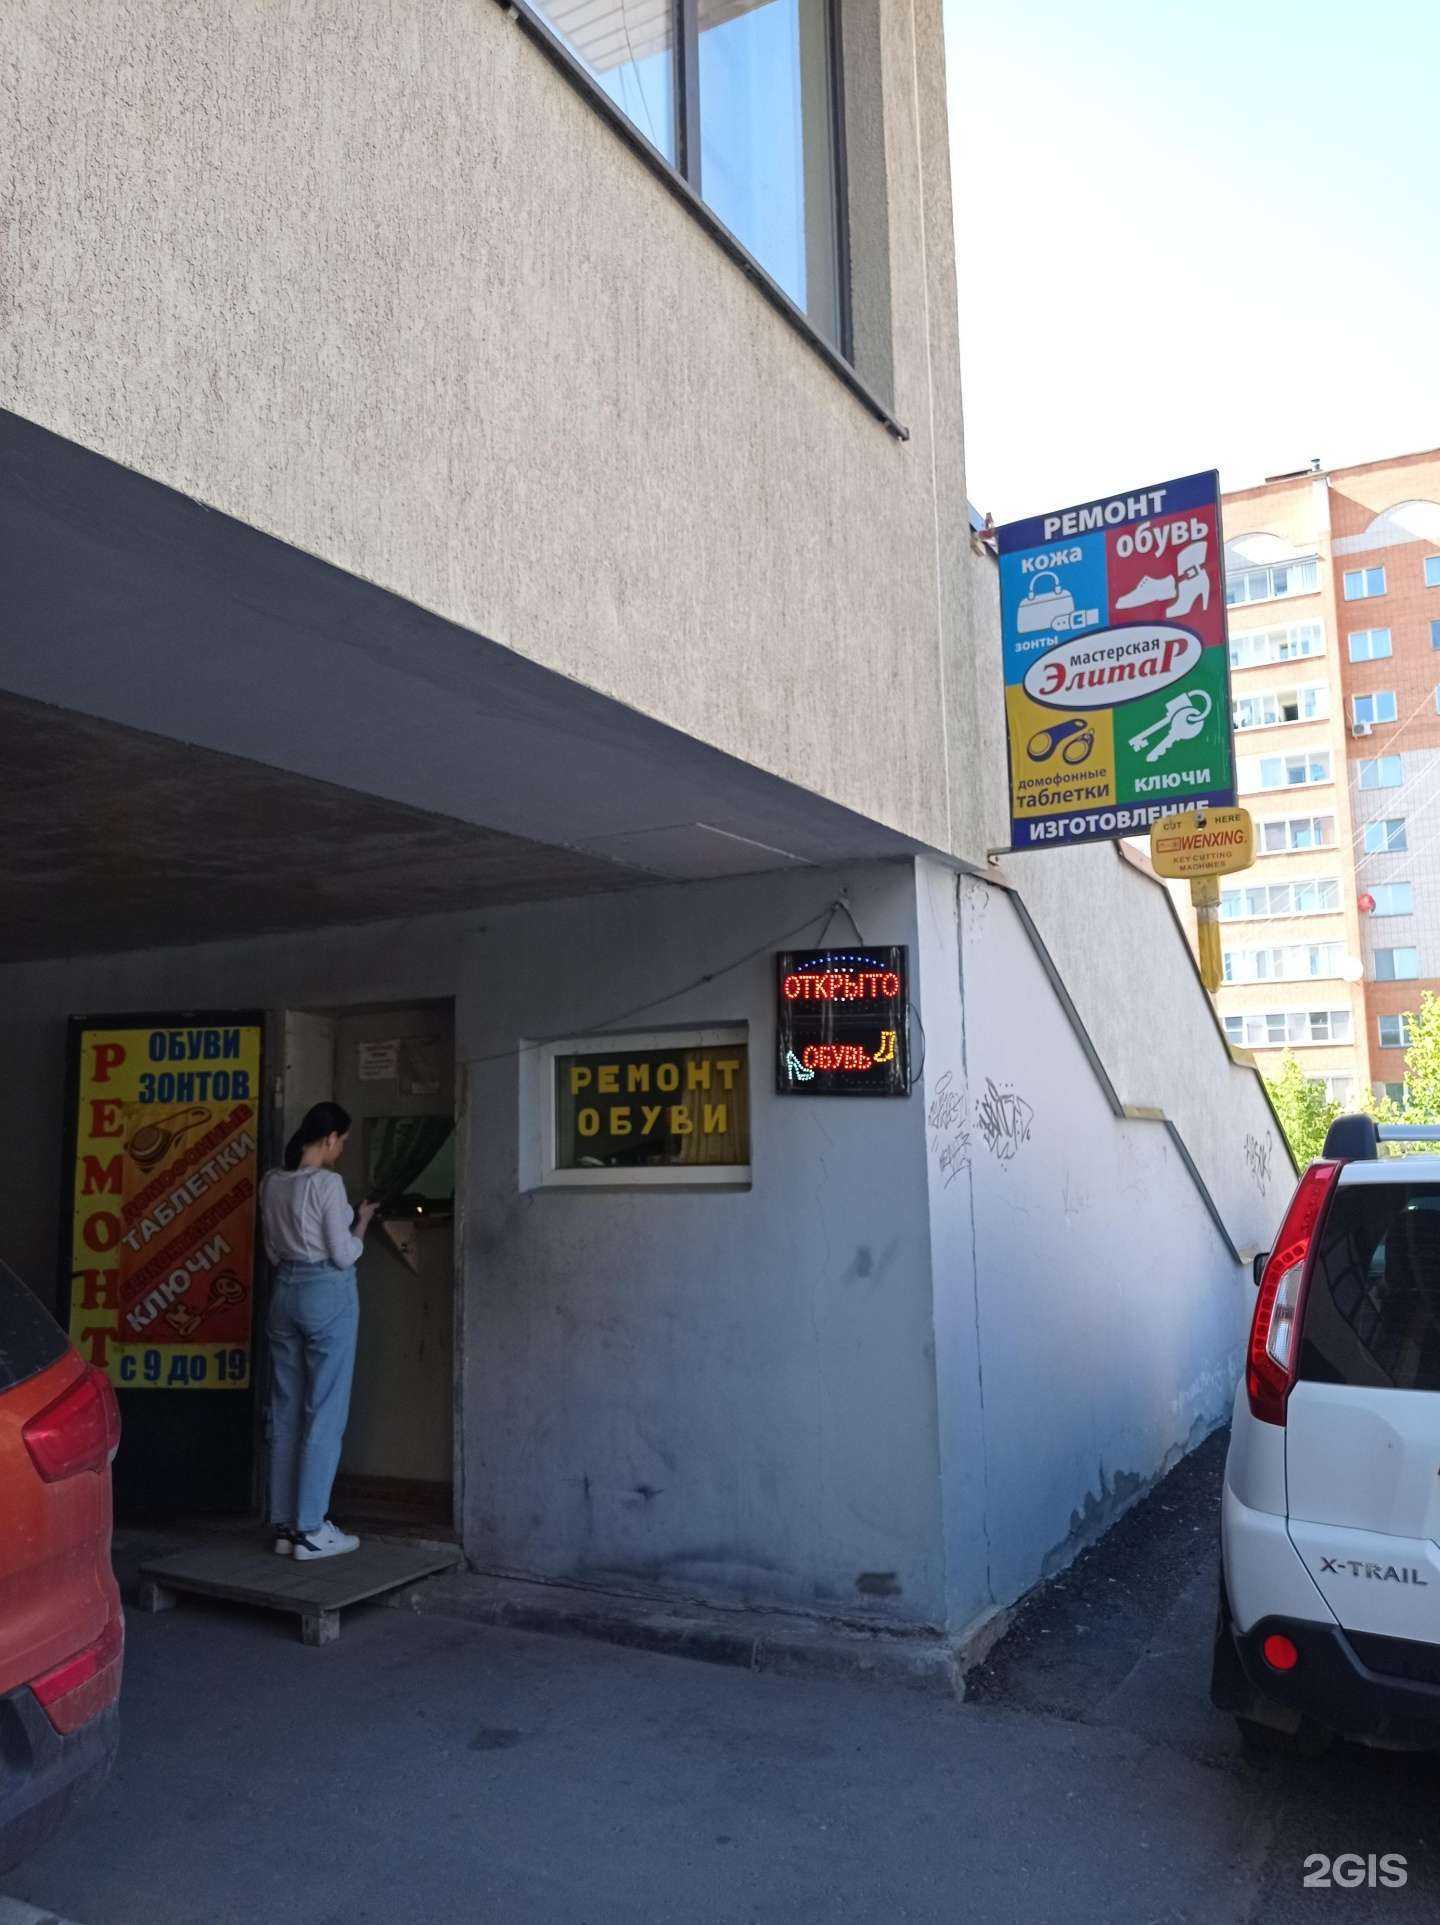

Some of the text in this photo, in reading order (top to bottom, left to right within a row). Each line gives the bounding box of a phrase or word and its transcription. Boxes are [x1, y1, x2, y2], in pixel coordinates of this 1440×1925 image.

[1044, 490, 1168, 540] РЕМОНТ
[1116, 518, 1209, 559] обувь
[1021, 546, 1083, 574] кожа
[1014, 635, 1060, 653] зонты
[1069, 638, 1161, 667] мастерская
[1018, 768, 1107, 790] домофонные
[1134, 768, 1211, 793] ключи
[1017, 784, 1110, 809] таблетки
[1163, 814, 1241, 831] CUT HERE
[784, 973, 900, 999] ОТКРЫТО
[148, 1029, 241, 1063] ОБУВИ
[803, 1045, 872, 1070] ОБУВЬ
[138, 1070, 251, 1105] ЗОНТОВ
[569, 1059, 741, 1096] РЕМОНТ
[577, 1104, 729, 1138] ОБУВИ
[121, 1131, 257, 1253] ТАБЛЕТКИ
[125, 1233, 233, 1334] КЛЮЧИ
[143, 1349, 161, 1381] 9
[167, 1354, 207, 1386] до
[213, 1349, 247, 1382] 19
[1319, 1556, 1429, 1587] X-TRAIL
